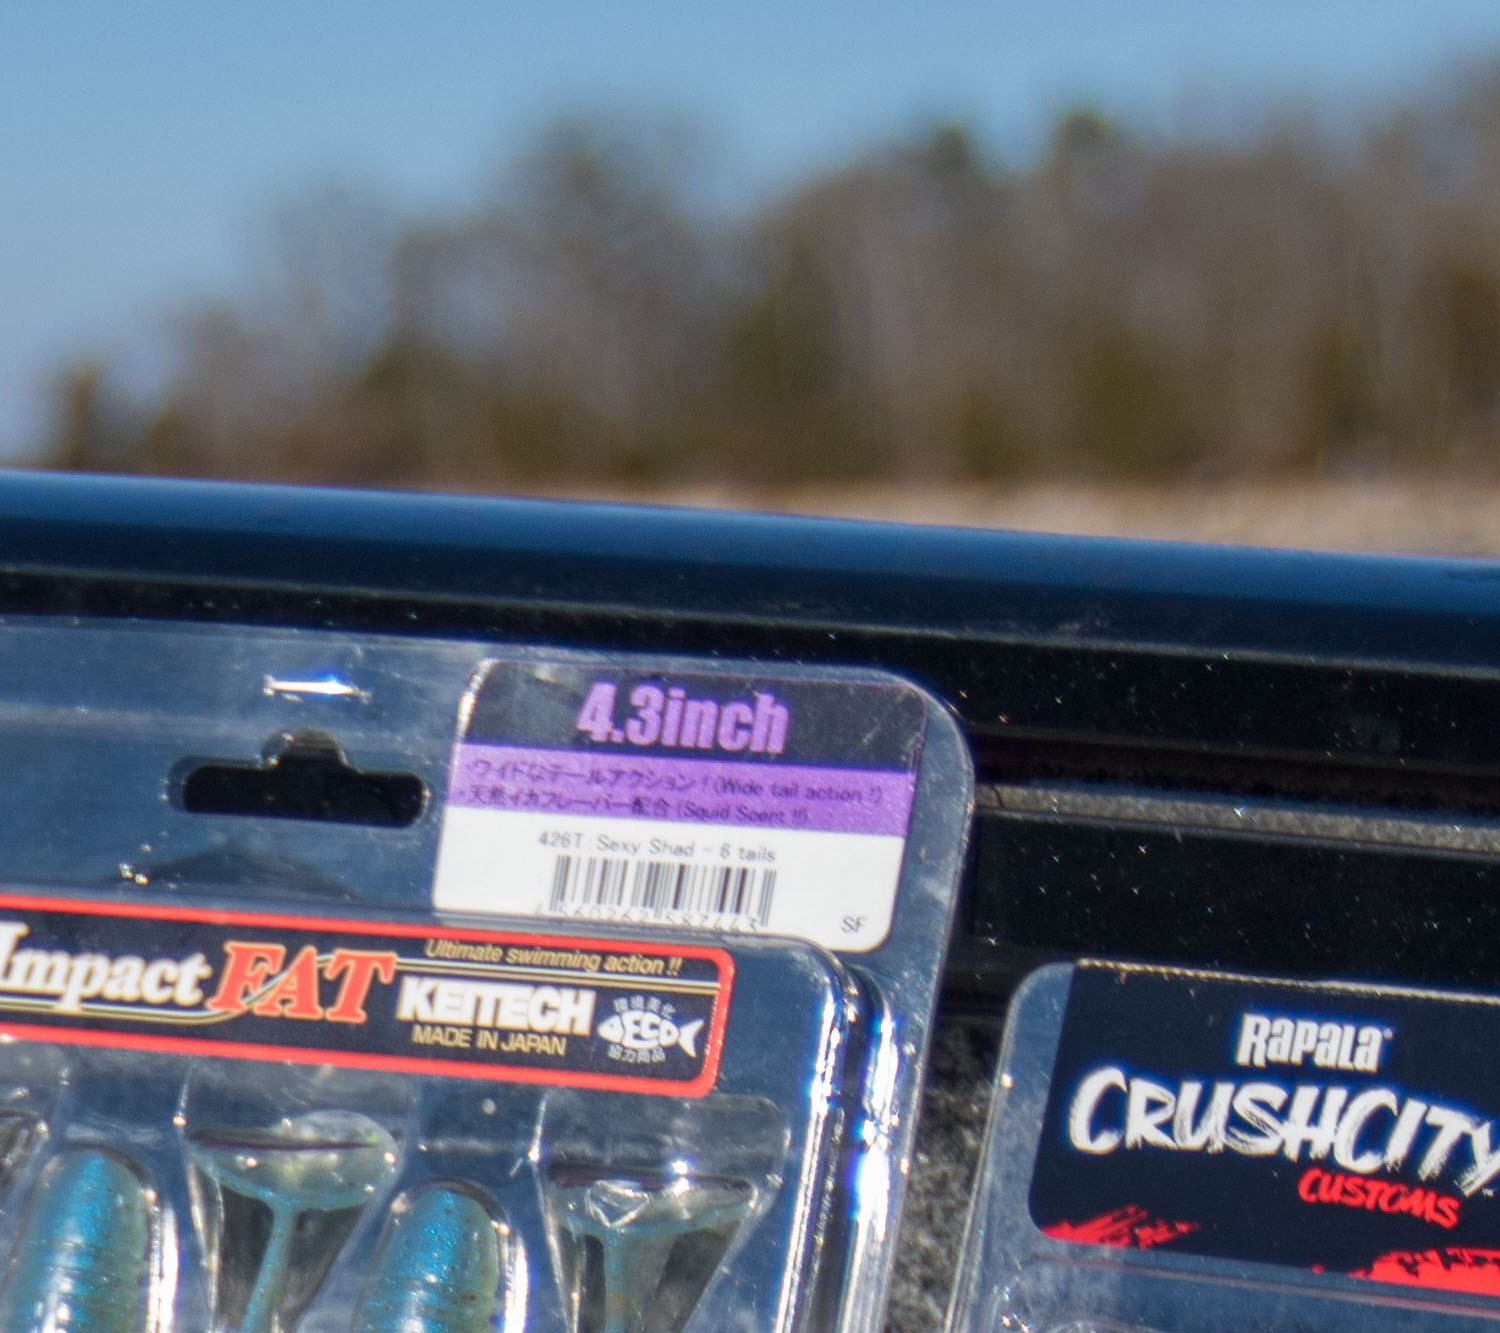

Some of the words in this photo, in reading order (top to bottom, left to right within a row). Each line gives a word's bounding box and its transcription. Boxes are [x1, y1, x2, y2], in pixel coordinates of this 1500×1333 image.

[576, 681, 790, 754] 4.3inch
[771, 781, 800, 799] tail
[804, 784, 864, 803] action
[736, 803, 785, 824] Scent
[538, 831, 584, 850] 426T
[596, 835, 642, 856] Sexy
[648, 838, 696, 858] Shad
[719, 842, 731, 860] 6
[738, 845, 777, 864] tails
[424, 938, 503, 962] Ultimate
[506, 943, 601, 974] swimming
[603, 952, 665, 976] action
[205, 940, 399, 1023] FAT
[397, 974, 597, 1036] KEITECH
[411, 1024, 471, 1049] MADE
[476, 1029, 499, 1051] IN
[501, 1033, 567, 1058] JAPAN
[621, 1009, 680, 1050] ECO
[1237, 1013, 1384, 1074] Rapala
[1298, 1166, 1461, 1230] CUSTOMS
